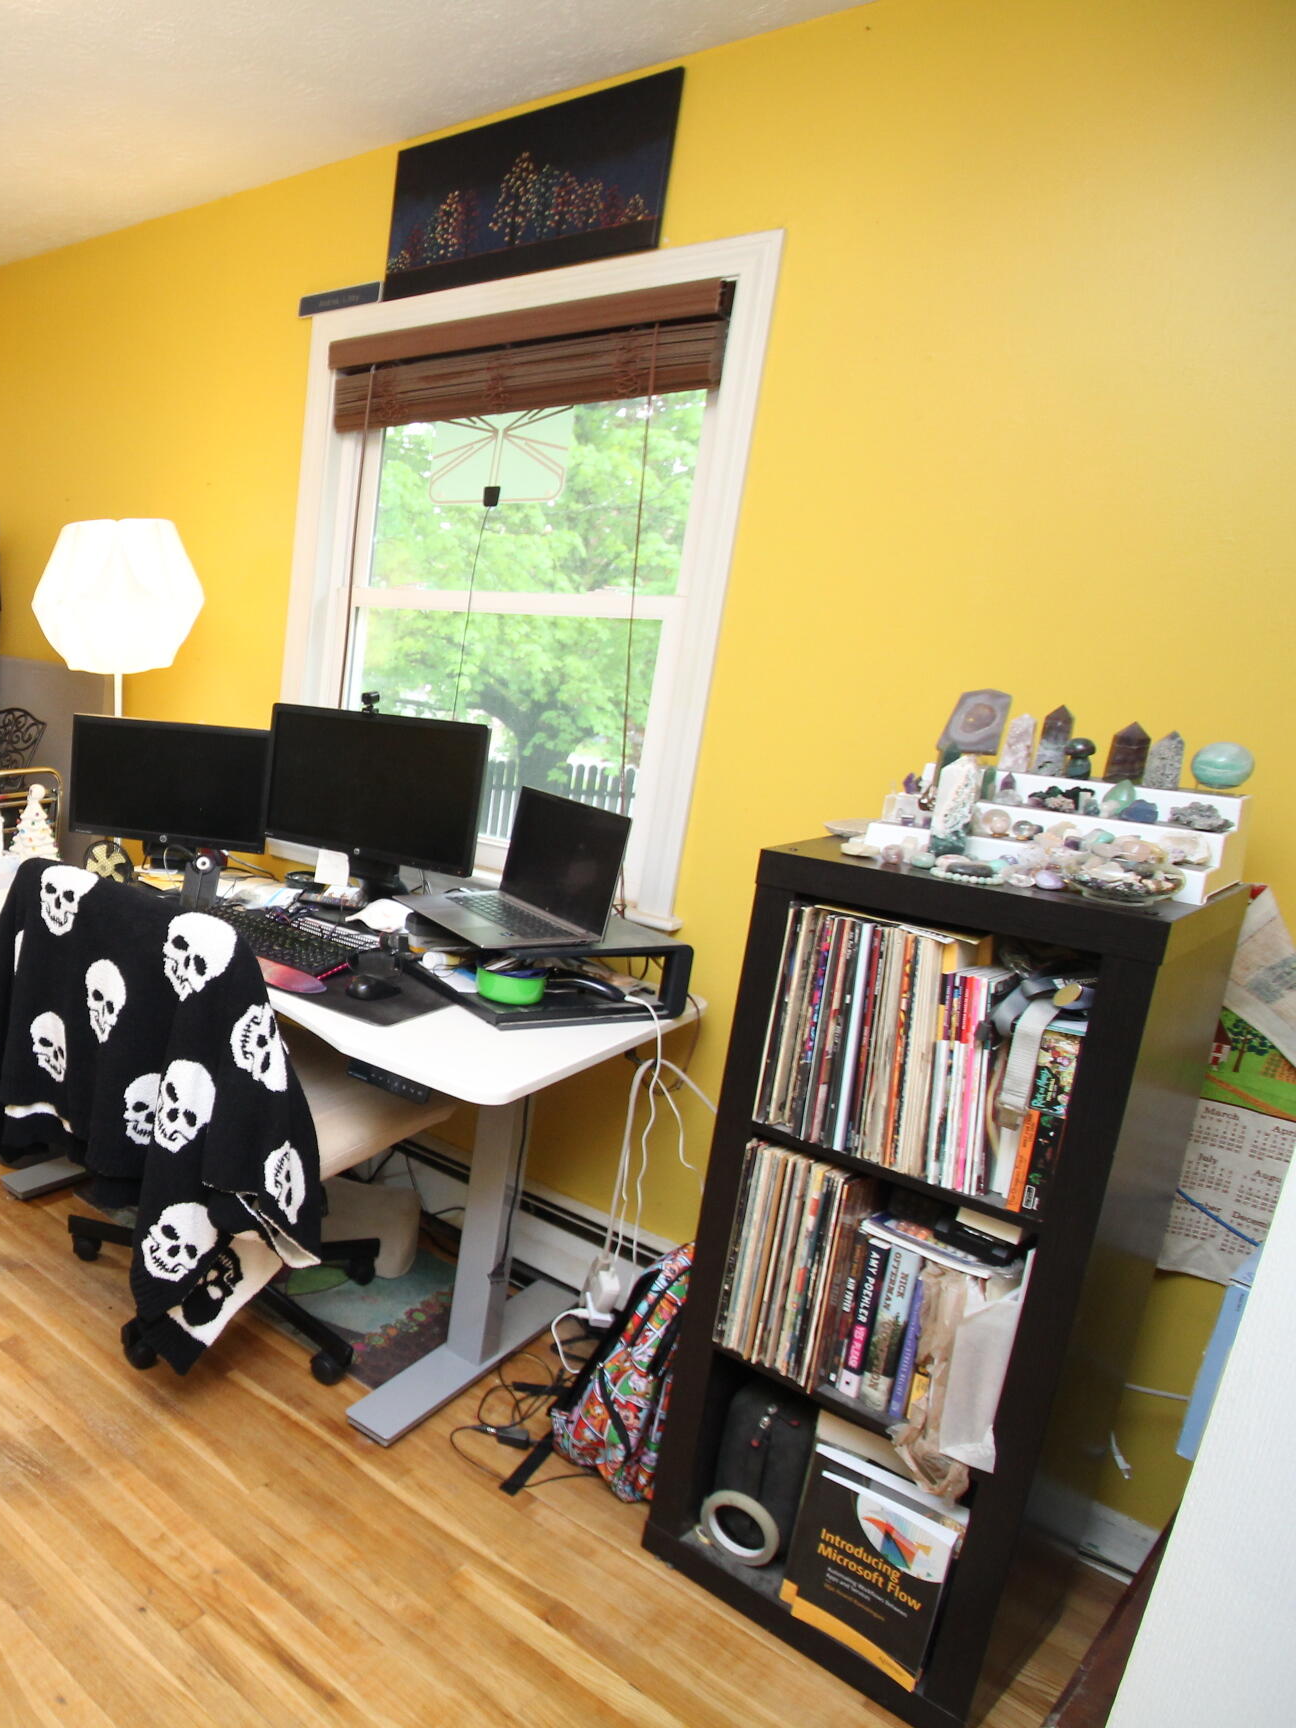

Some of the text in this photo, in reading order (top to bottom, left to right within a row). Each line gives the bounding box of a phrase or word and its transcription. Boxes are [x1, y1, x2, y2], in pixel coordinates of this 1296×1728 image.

[1204, 1106, 1240, 1121] March
[1272, 1125, 1296, 1138] Apri
[1198, 1153, 1218, 1165] July
[1254, 1169, 1282, 1183] Augu
[1231, 1210, 1269, 1228] Decem
[870, 1251, 881, 1271] AMY
[881, 1252, 902, 1312] OFFERMAN
[897, 1271, 908, 1300] NICK
[857, 1273, 876, 1324] POEHLER
[820, 1527, 902, 1584] Introducing
[817, 1542, 884, 1588] Microsoft
[887, 1583, 922, 1612] Flow
